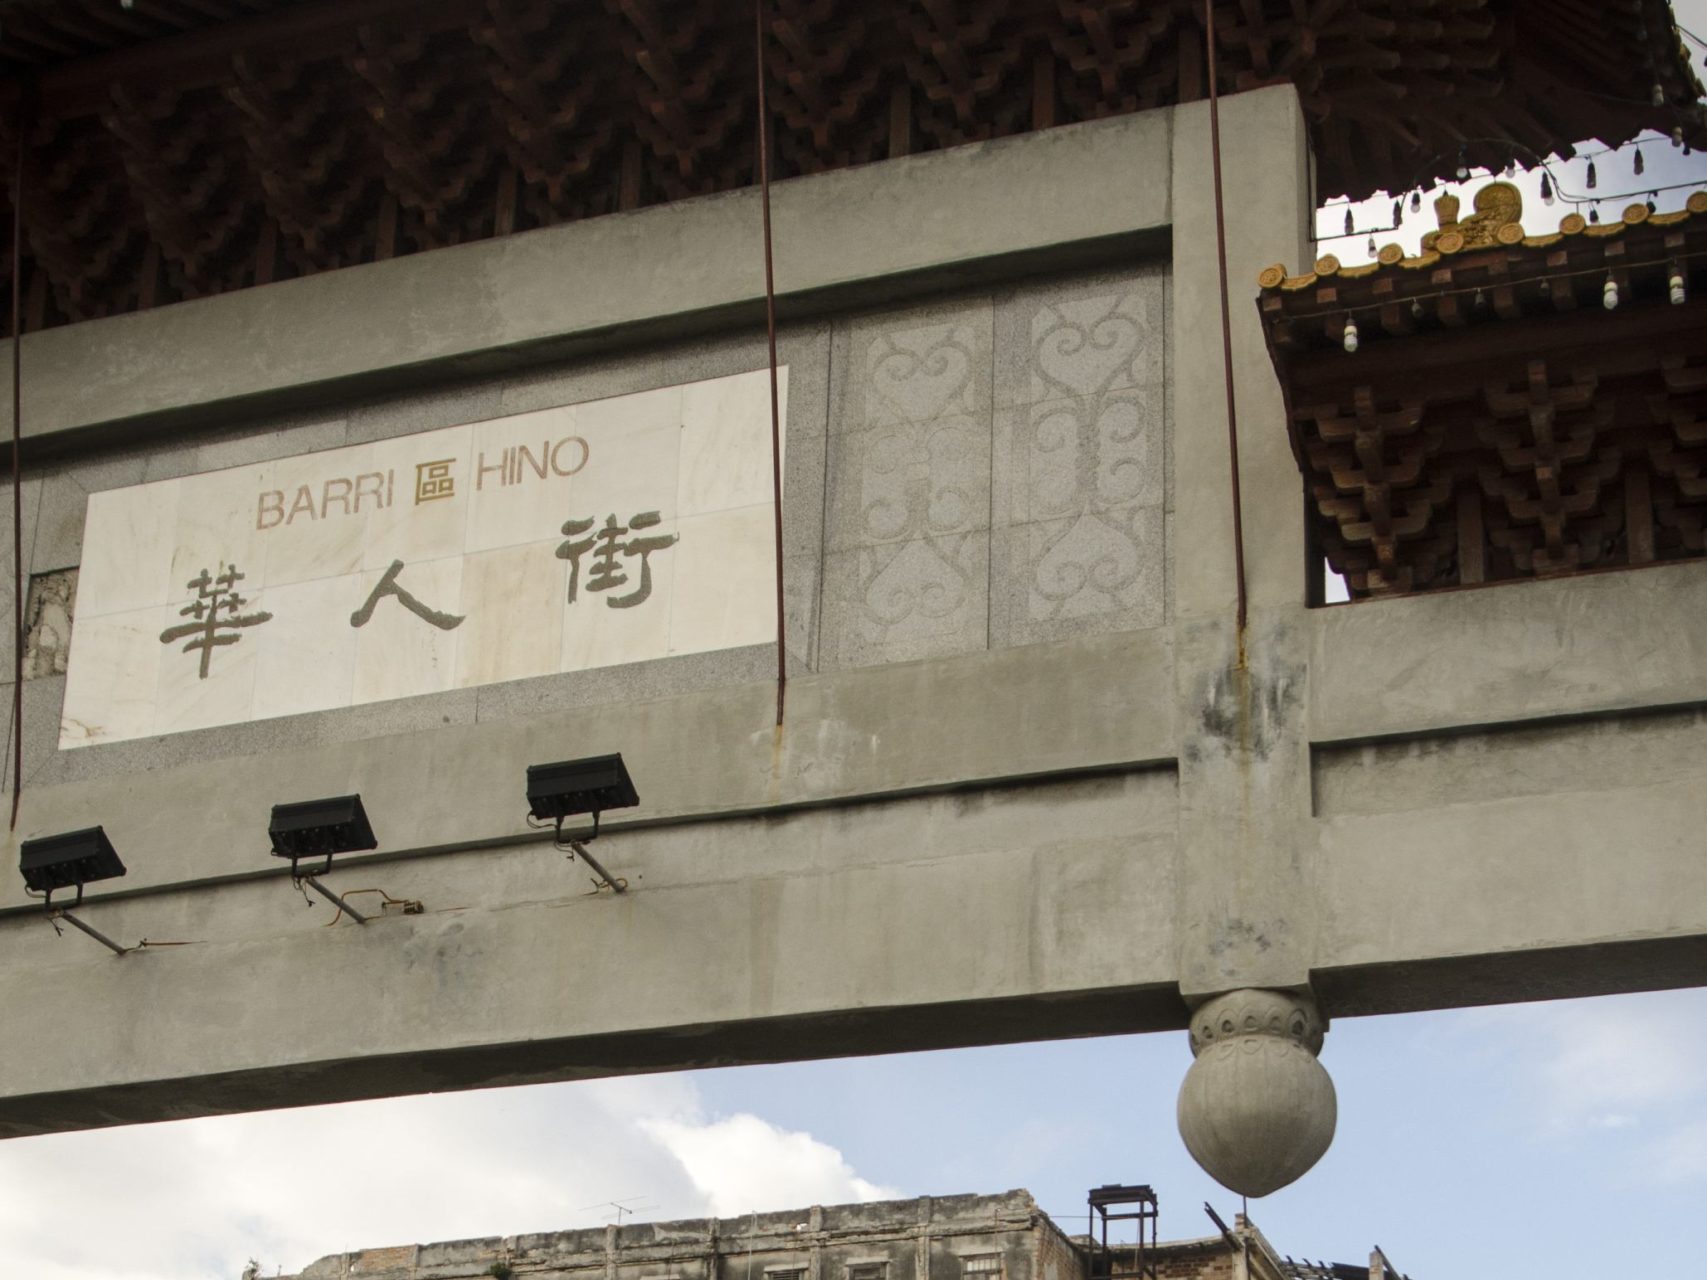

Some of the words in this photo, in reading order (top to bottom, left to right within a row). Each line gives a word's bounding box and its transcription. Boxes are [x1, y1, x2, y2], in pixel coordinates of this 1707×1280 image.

[256, 469, 394, 530] BARRI
[415, 458, 456, 506] 區
[476, 435, 590, 492] HINO
